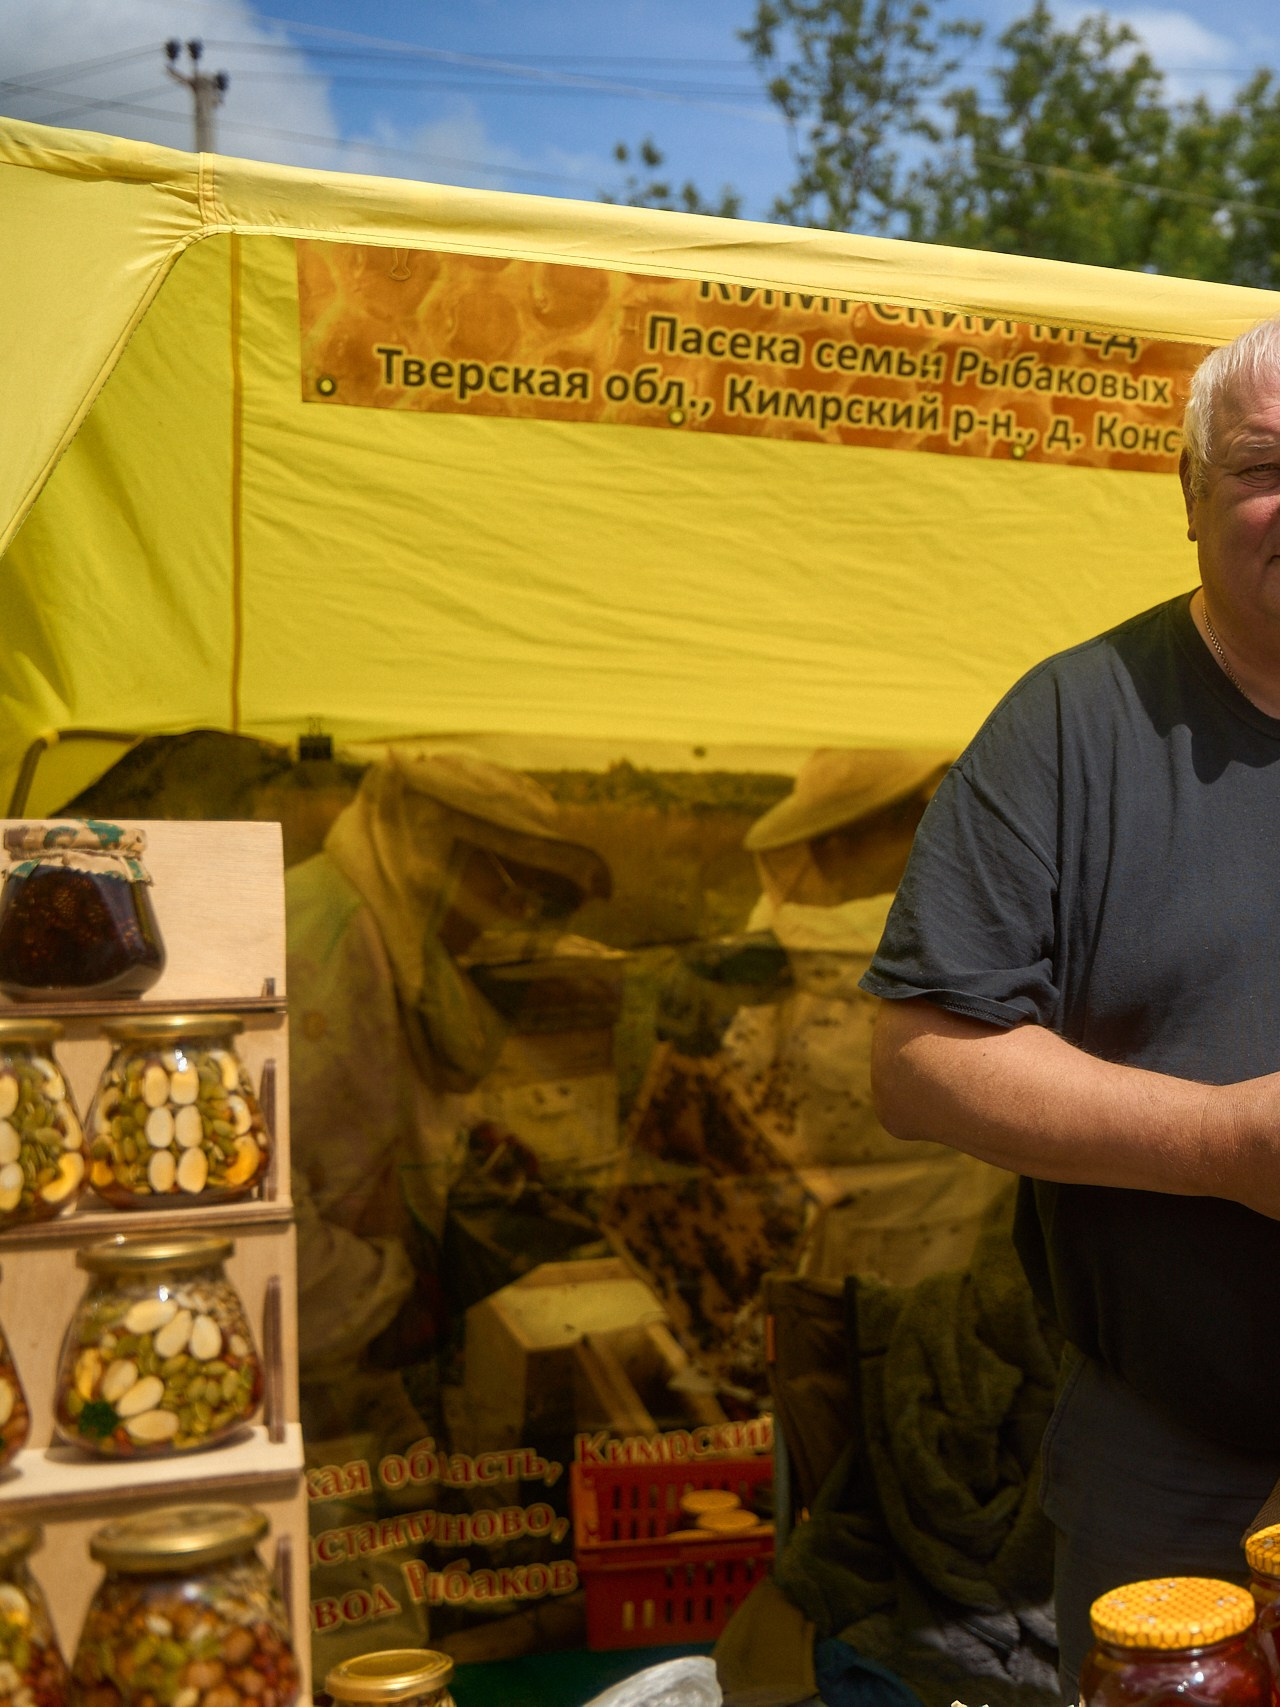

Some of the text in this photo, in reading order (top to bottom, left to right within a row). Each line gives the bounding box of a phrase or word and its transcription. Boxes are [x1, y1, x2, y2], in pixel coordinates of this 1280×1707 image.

[376, 347, 589, 400] Тверская
[605, 368, 711, 416] обл.,
[728, 377, 940, 431] Кимрский
[953, 408, 1035, 446] р-н.,
[1047, 418, 1082, 450] д.
[648, 315, 1169, 404] Пасека семьи Рыбаковых
[308, 1504, 568, 1564] стантиново,
